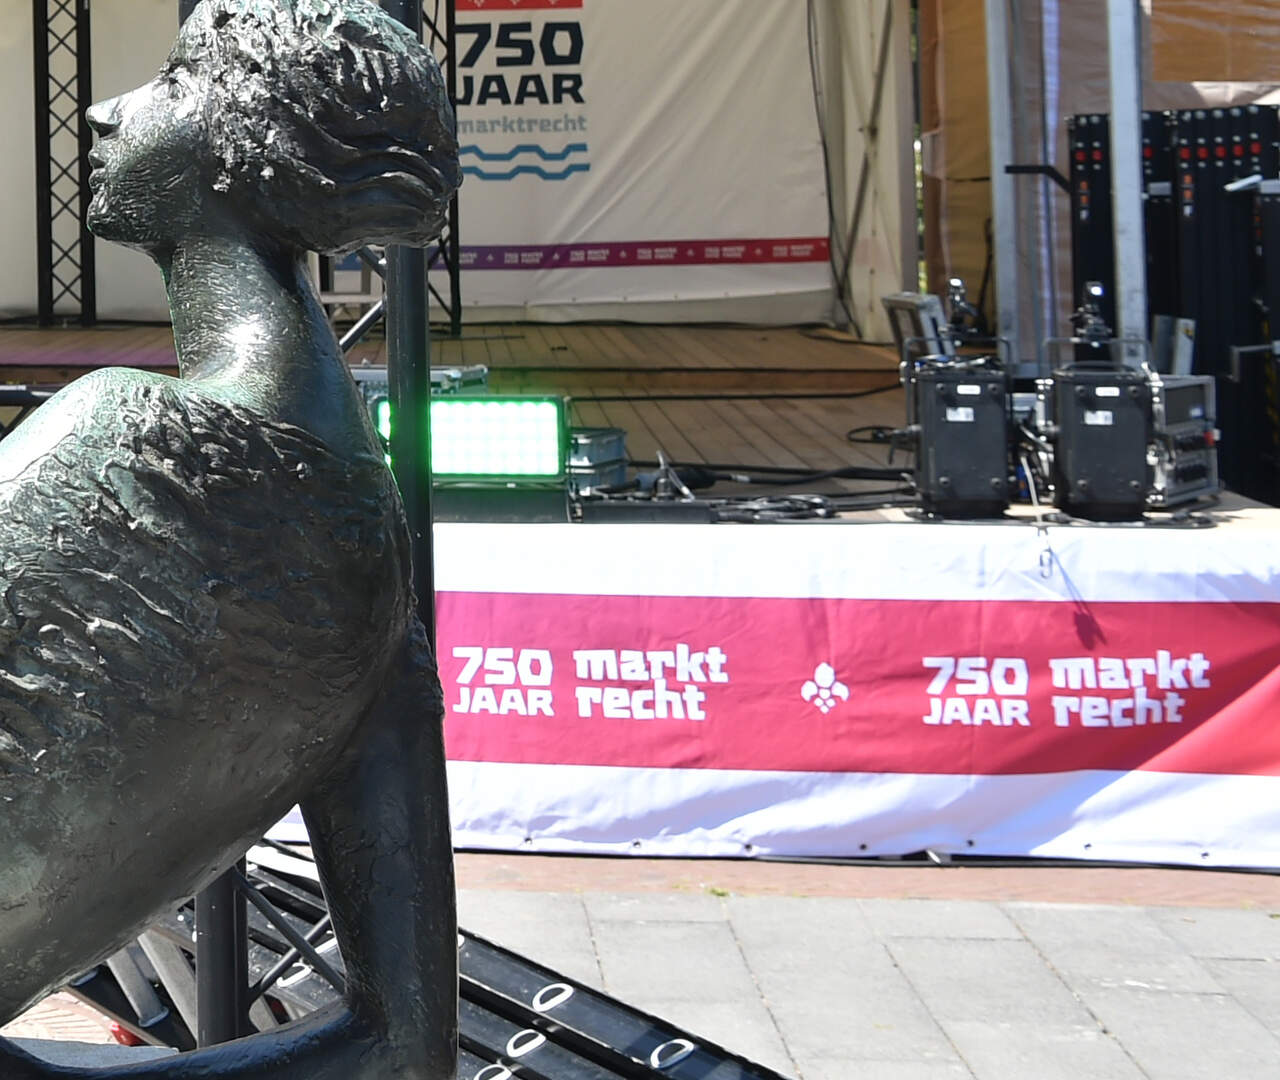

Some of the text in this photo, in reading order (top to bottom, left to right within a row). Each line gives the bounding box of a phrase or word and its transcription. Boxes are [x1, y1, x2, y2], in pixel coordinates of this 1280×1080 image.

[454, 22, 584, 68] 750
[455, 74, 585, 106] JAAR
[456, 114, 587, 134] marktrecht
[452, 646, 554, 686] 750
[573, 643, 729, 683] markt
[922, 656, 1029, 696] 750
[1048, 649, 1211, 690] markt
[452, 686, 555, 717] JAAR
[575, 677, 707, 720] recht
[922, 697, 1031, 726] JAAR
[1051, 685, 1186, 728] recht
